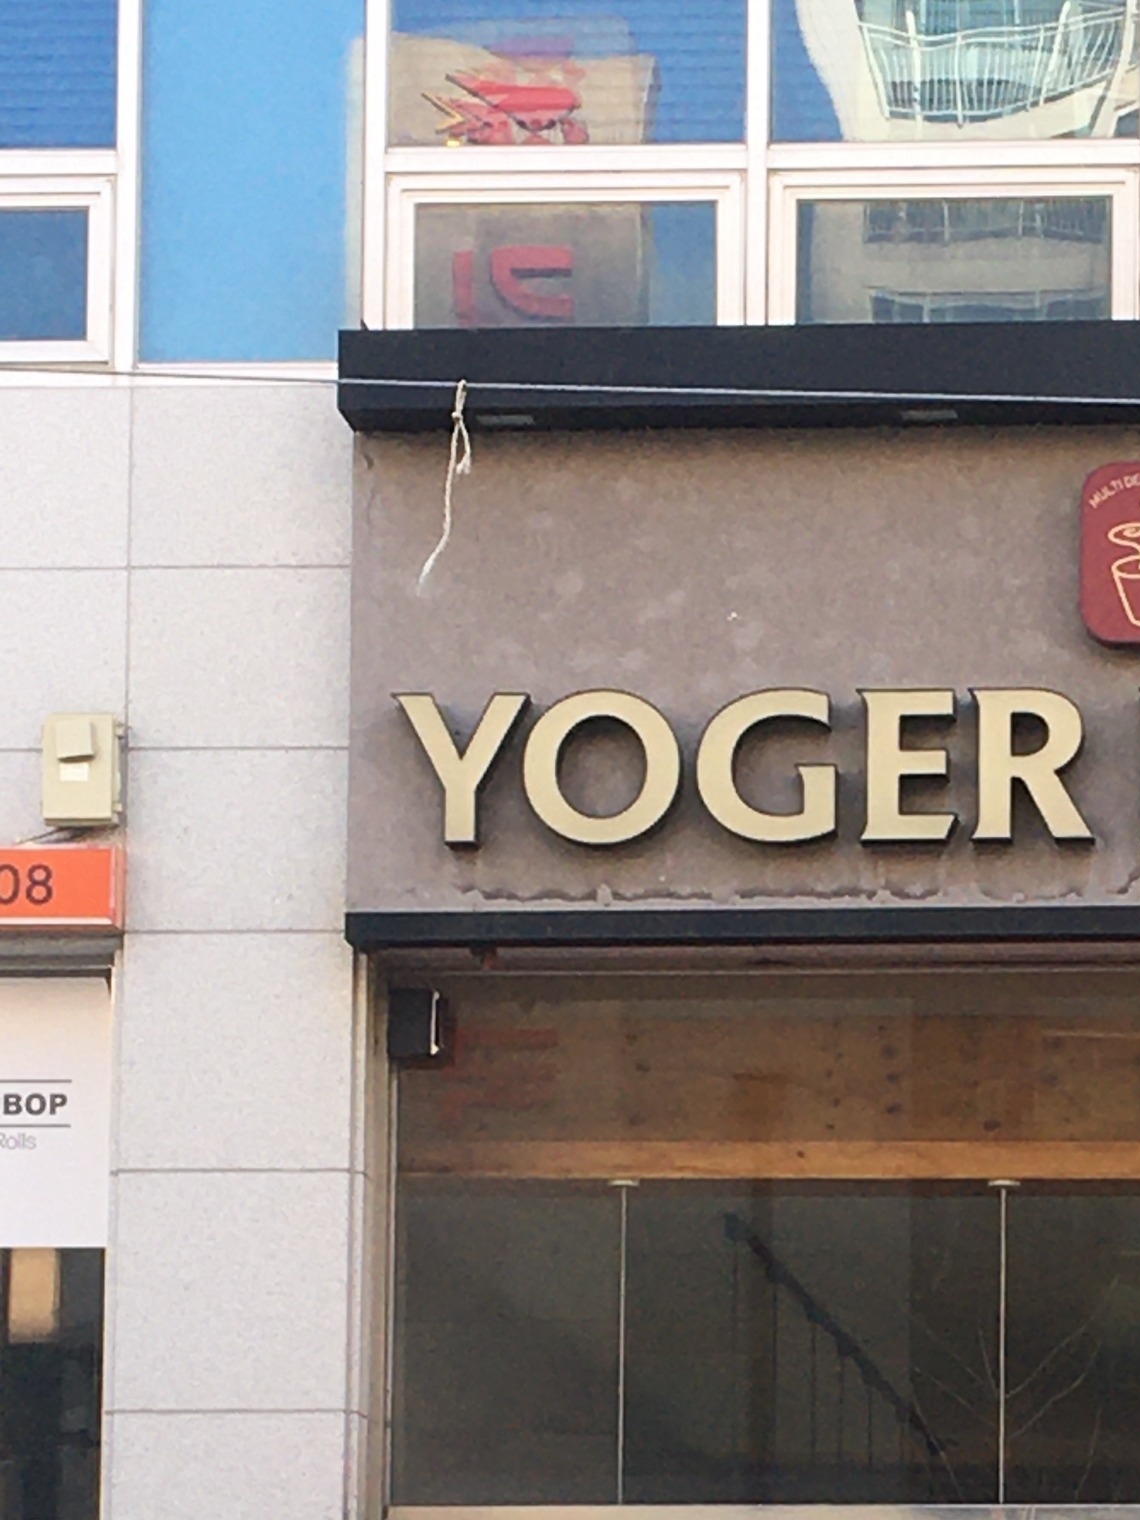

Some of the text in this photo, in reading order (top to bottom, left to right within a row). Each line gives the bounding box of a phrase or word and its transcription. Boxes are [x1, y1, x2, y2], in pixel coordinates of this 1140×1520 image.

[1088, 478, 1124, 509] MULTI
[391, 688, 1094, 847] YOGER
[3, 1093, 68, 1116] BOP
